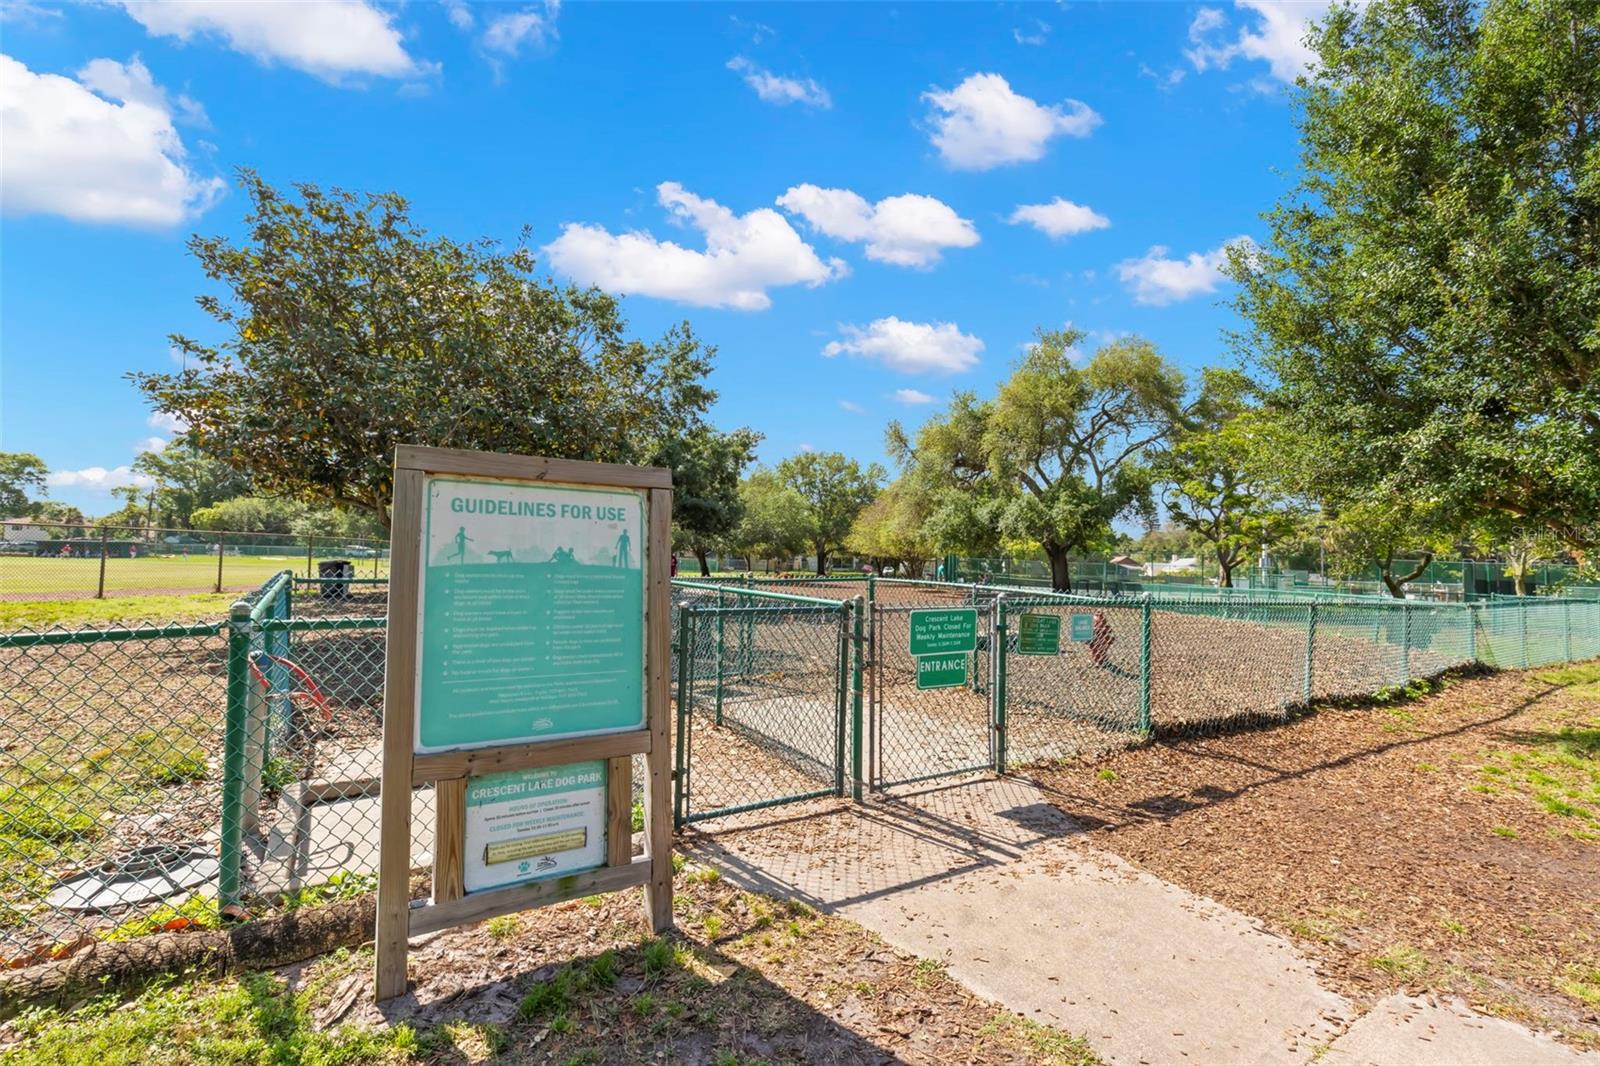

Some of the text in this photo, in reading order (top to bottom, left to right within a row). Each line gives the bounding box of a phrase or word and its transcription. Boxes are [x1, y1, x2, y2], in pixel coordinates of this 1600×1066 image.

[451, 497, 626, 522] GUIDELINES FOR USE
[915, 625, 926, 633] Dog
[920, 659, 965, 673] ENTRANCE
[472, 772, 602, 800] CRESCENT LAKE DOG PARK
